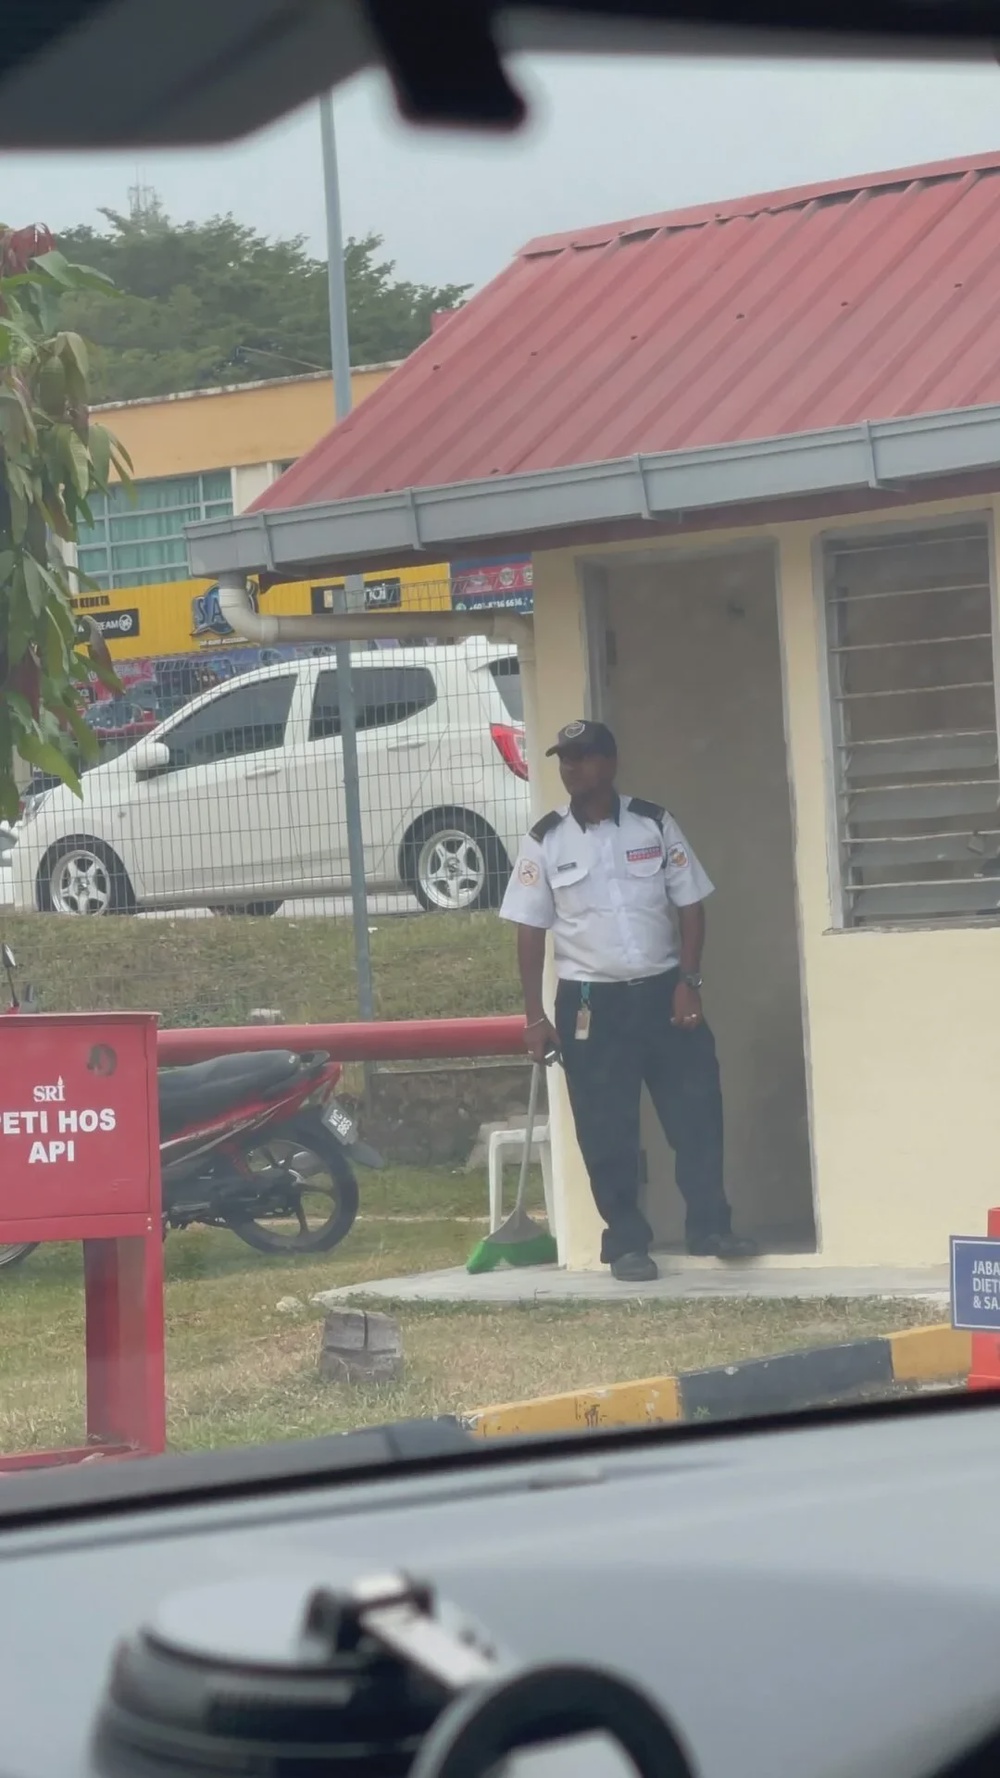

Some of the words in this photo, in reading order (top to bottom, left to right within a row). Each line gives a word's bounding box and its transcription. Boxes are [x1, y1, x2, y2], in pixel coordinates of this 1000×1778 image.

[33, 1075, 66, 1103] SRI
[0, 1111, 48, 1134] ETI
[58, 1108, 116, 1133] HOS
[28, 1140, 75, 1164] API
[972, 1260, 1000, 1276] JABA
[973, 1277, 1000, 1294] DIET
[973, 1295, 982, 1309] &
